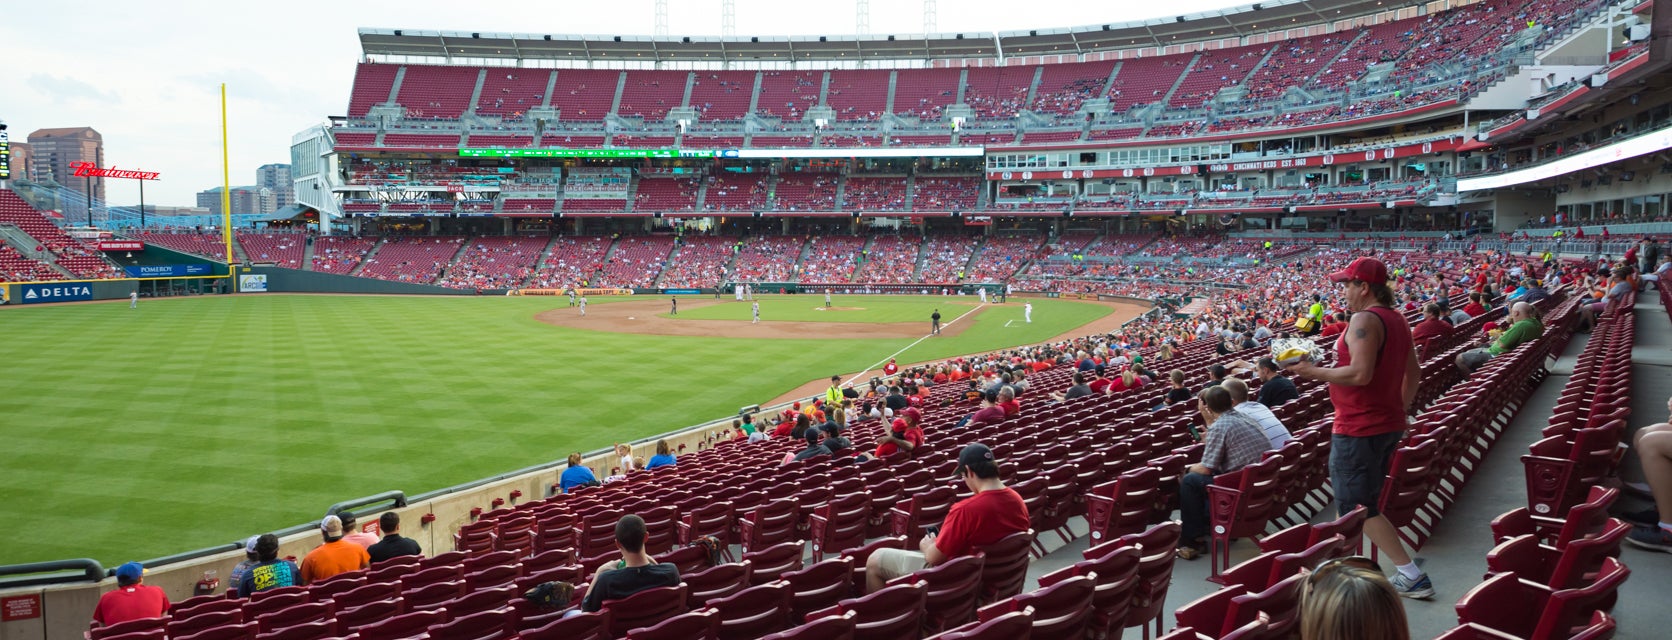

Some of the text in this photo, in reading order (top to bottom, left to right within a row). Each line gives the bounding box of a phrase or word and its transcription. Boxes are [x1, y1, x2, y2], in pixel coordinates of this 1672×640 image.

[69, 161, 159, 179] Budweiser
[1233, 161, 1262, 171] CINCINNATI
[1263, 160, 1277, 169] REDS
[41, 286, 90, 297] DELTA
